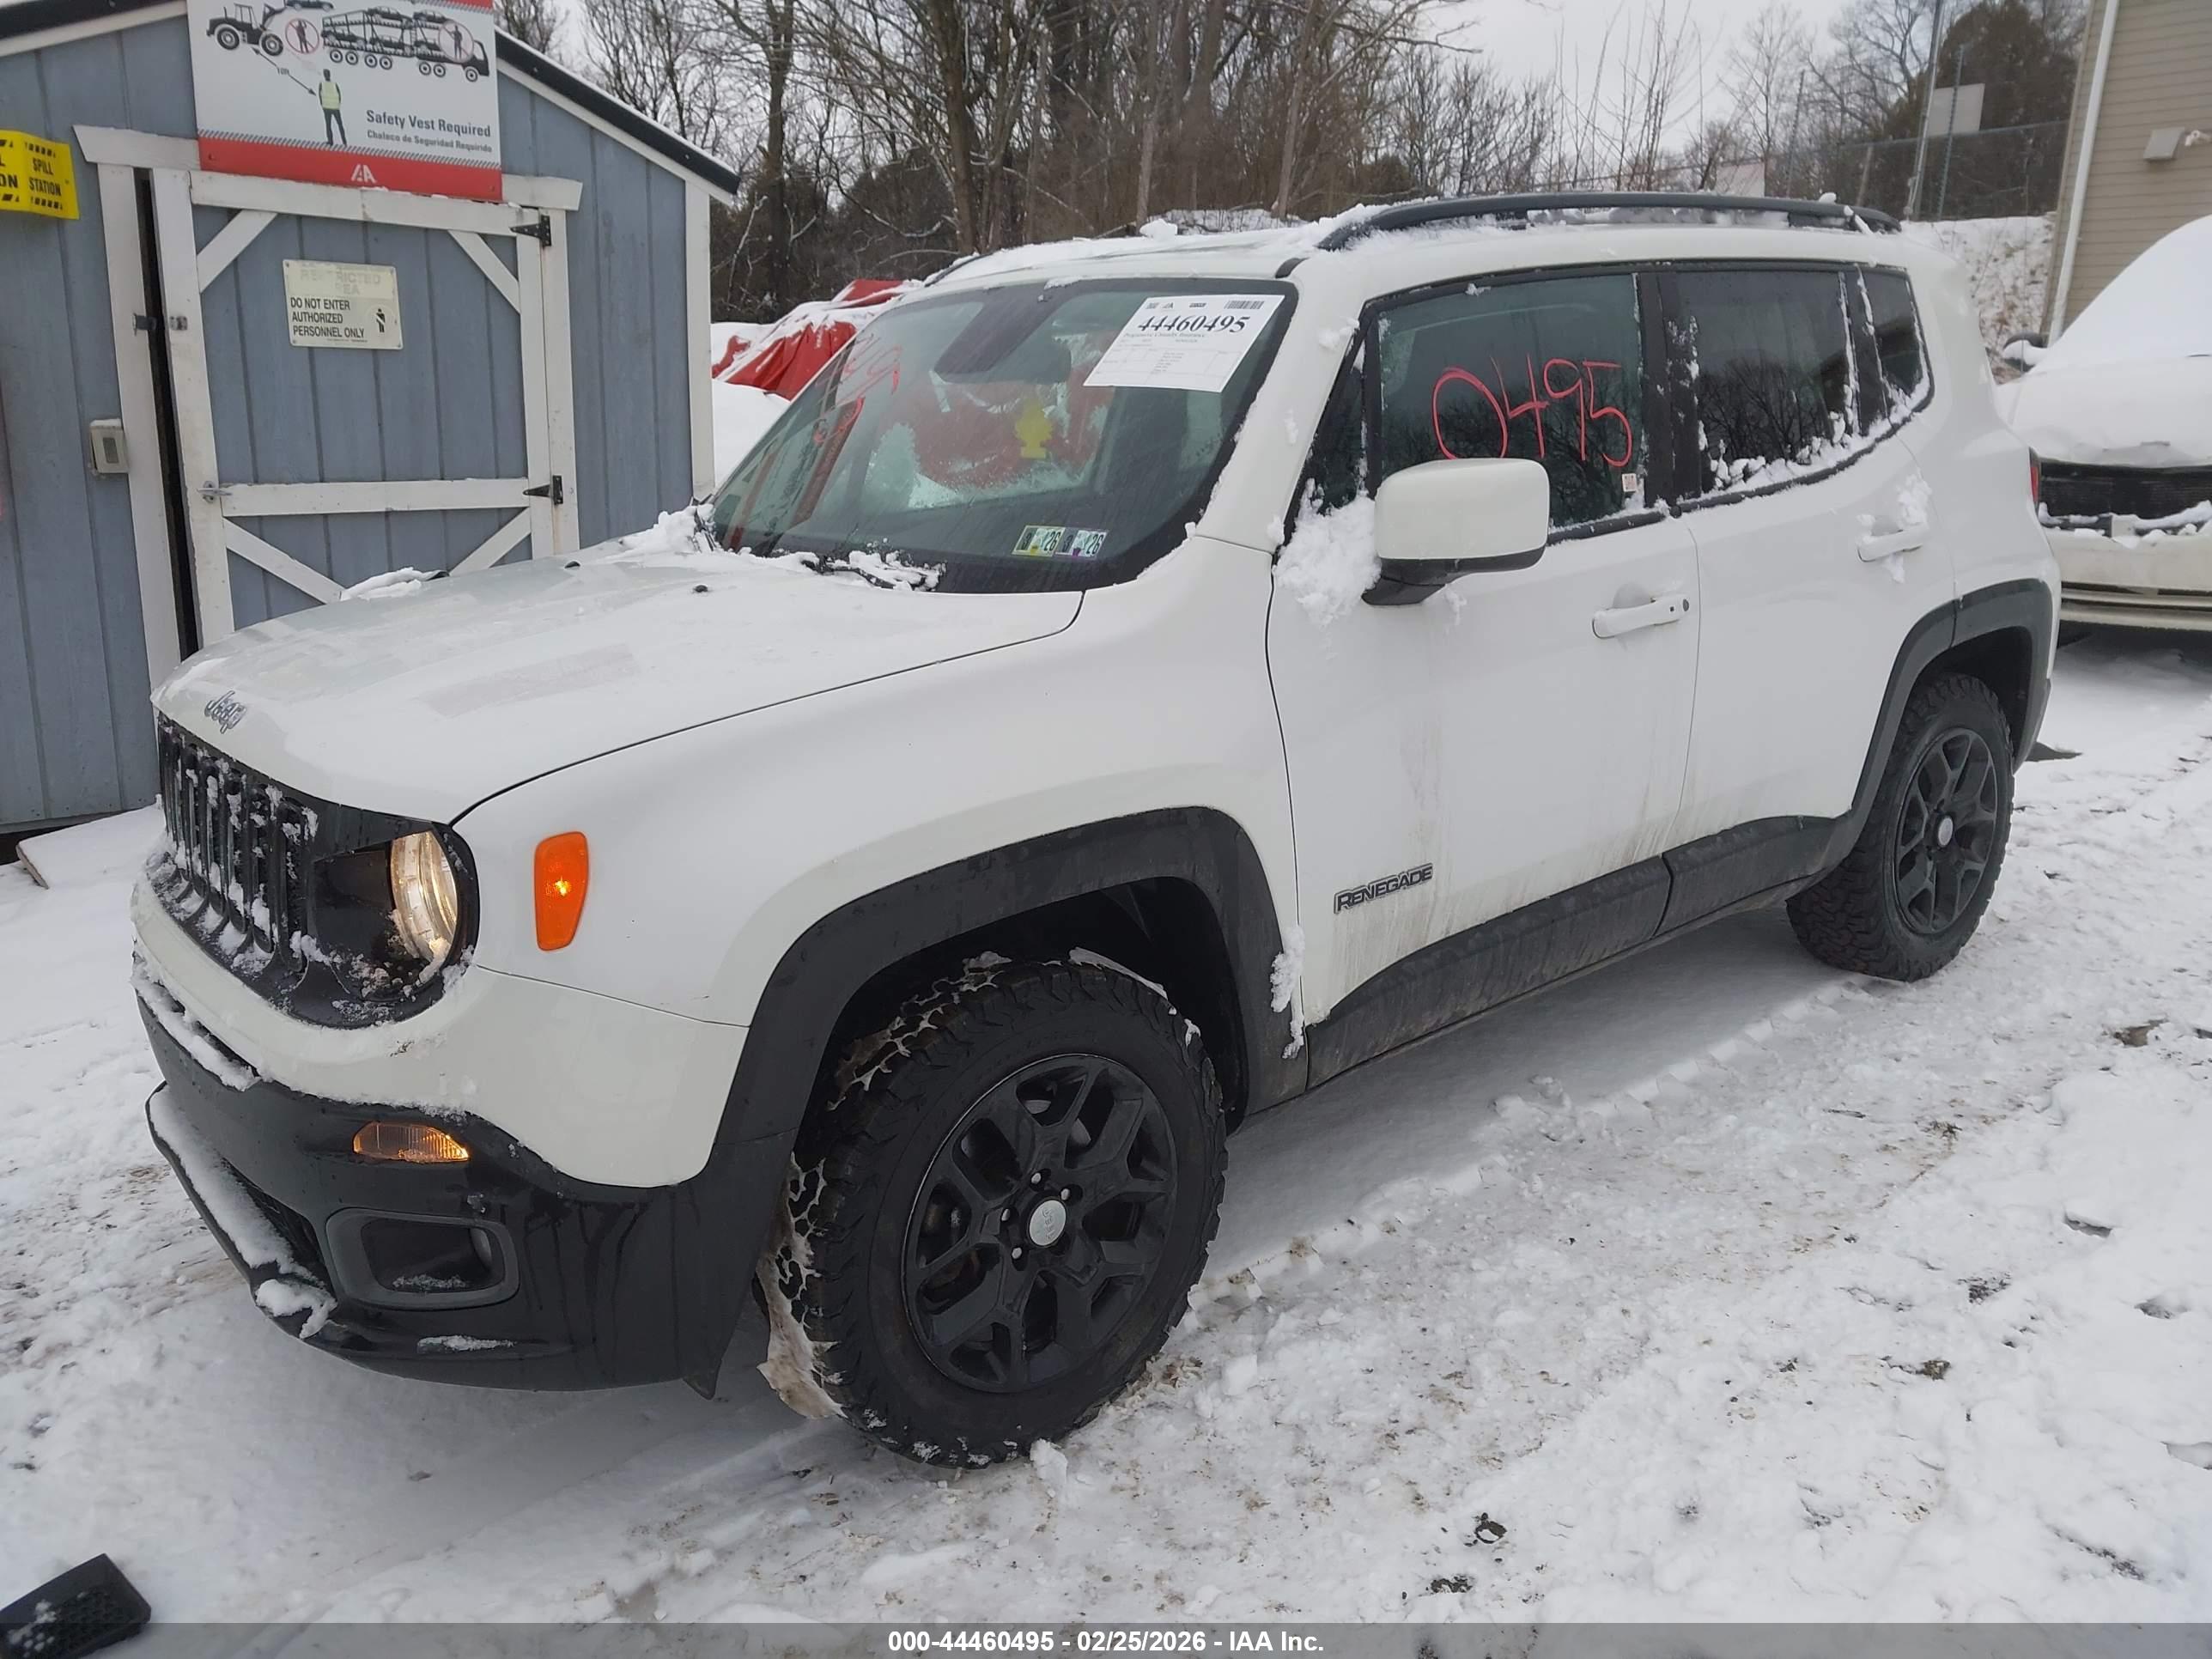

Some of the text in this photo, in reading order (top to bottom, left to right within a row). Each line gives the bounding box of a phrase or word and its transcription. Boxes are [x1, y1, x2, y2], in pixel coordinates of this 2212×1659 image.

[367, 110, 491, 137] Safety Vest Required
[414, 135, 454, 148] Seguridad
[33, 157, 54, 176] SPILL
[28, 177, 62, 197] STATION
[290, 297, 351, 310] DO NOT ENTER
[292, 311, 343, 324] AUTHORIZED
[1137, 315, 1251, 333] 44460495
[293, 325, 365, 338] PERSONNEL ONLY
[1432, 353, 1632, 467] 0495
[204, 690, 246, 734] Jeep
[1334, 862, 1433, 914] RENEGADE
